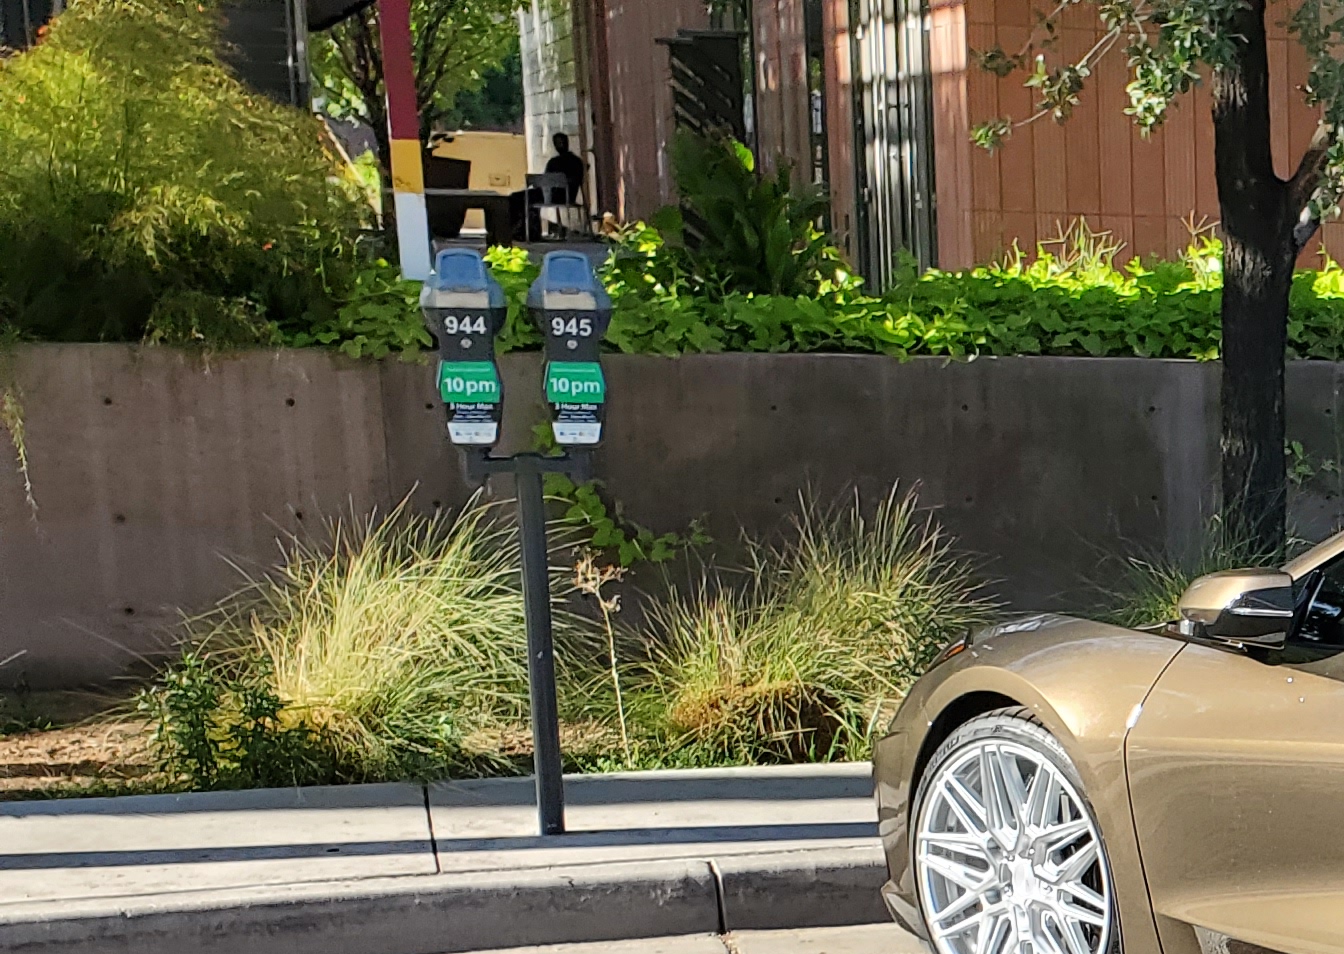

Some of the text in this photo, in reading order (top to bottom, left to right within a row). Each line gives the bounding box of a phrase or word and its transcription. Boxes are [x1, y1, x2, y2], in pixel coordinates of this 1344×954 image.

[444, 316, 487, 335] 944
[551, 317, 593, 336] 945
[444, 377, 496, 396] 10pm
[550, 377, 601, 396] 10pm
